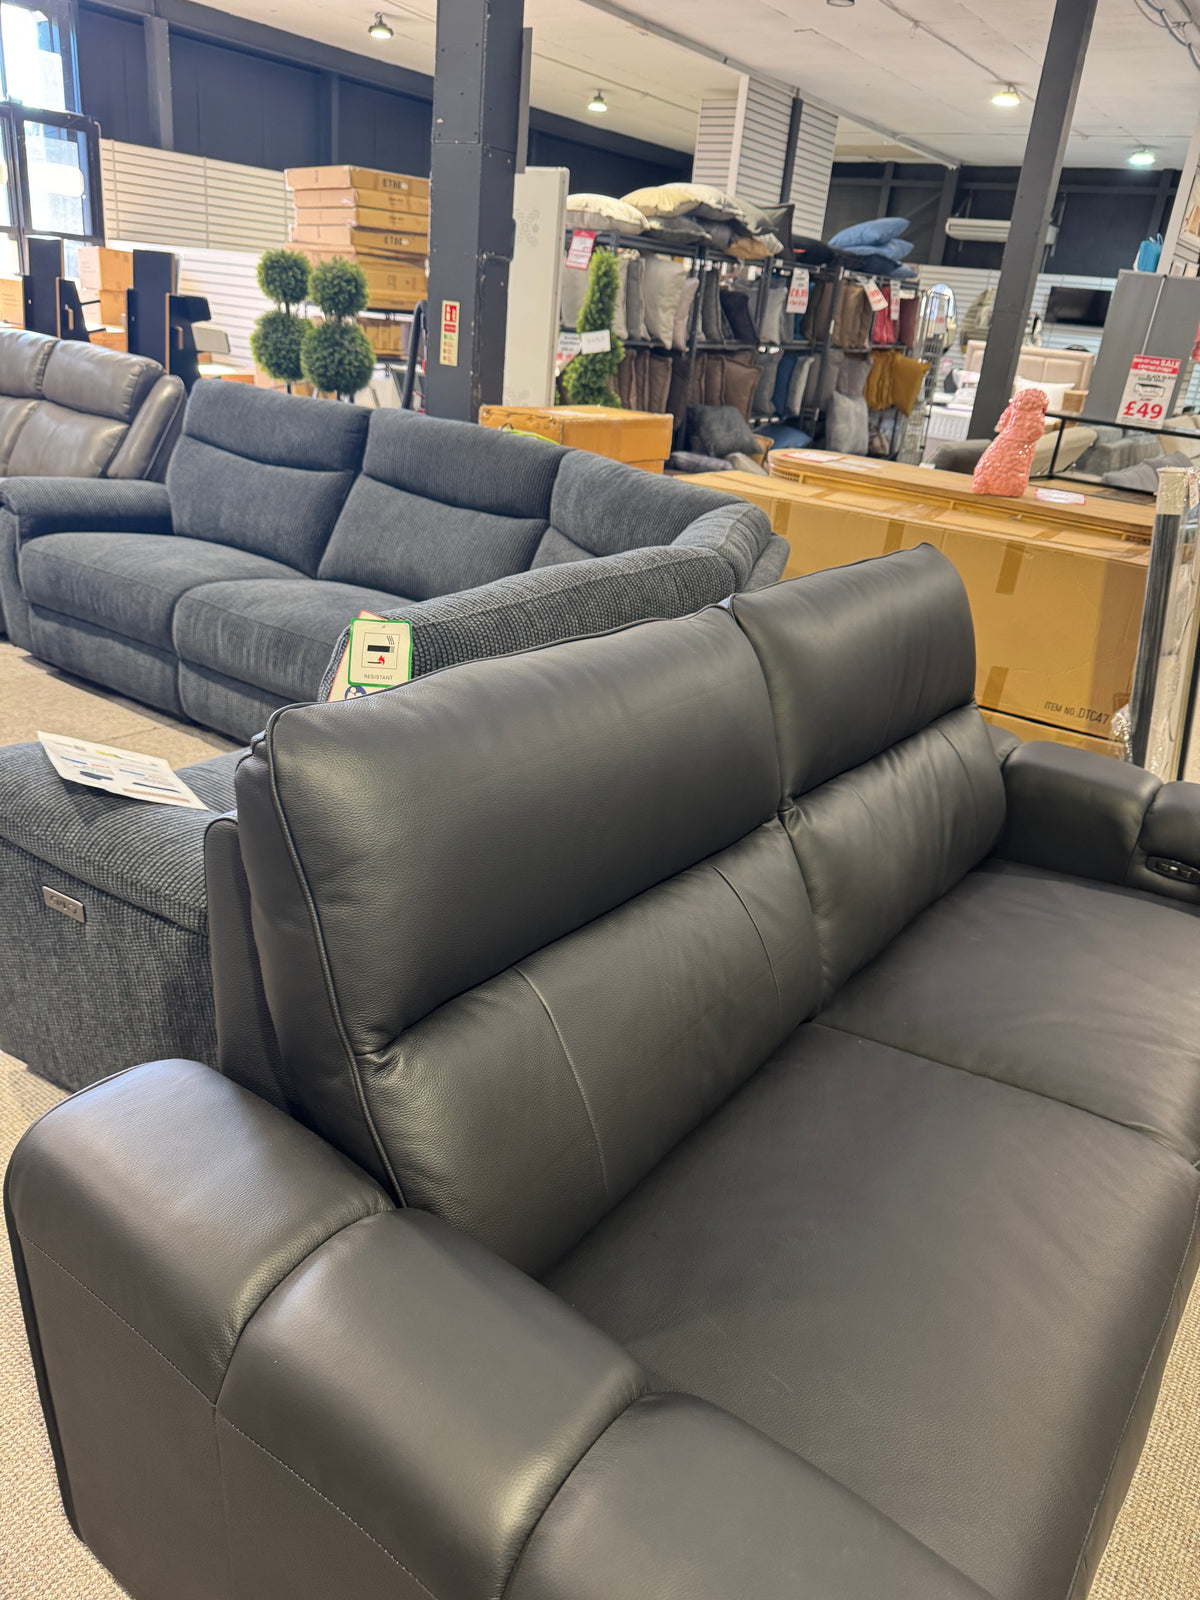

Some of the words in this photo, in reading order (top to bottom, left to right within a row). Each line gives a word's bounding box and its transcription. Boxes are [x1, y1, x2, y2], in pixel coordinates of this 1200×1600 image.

[1160, 359, 1181, 368] SALE
[1123, 400, 1163, 420] £49
[1044, 701, 1063, 713] ITEM
